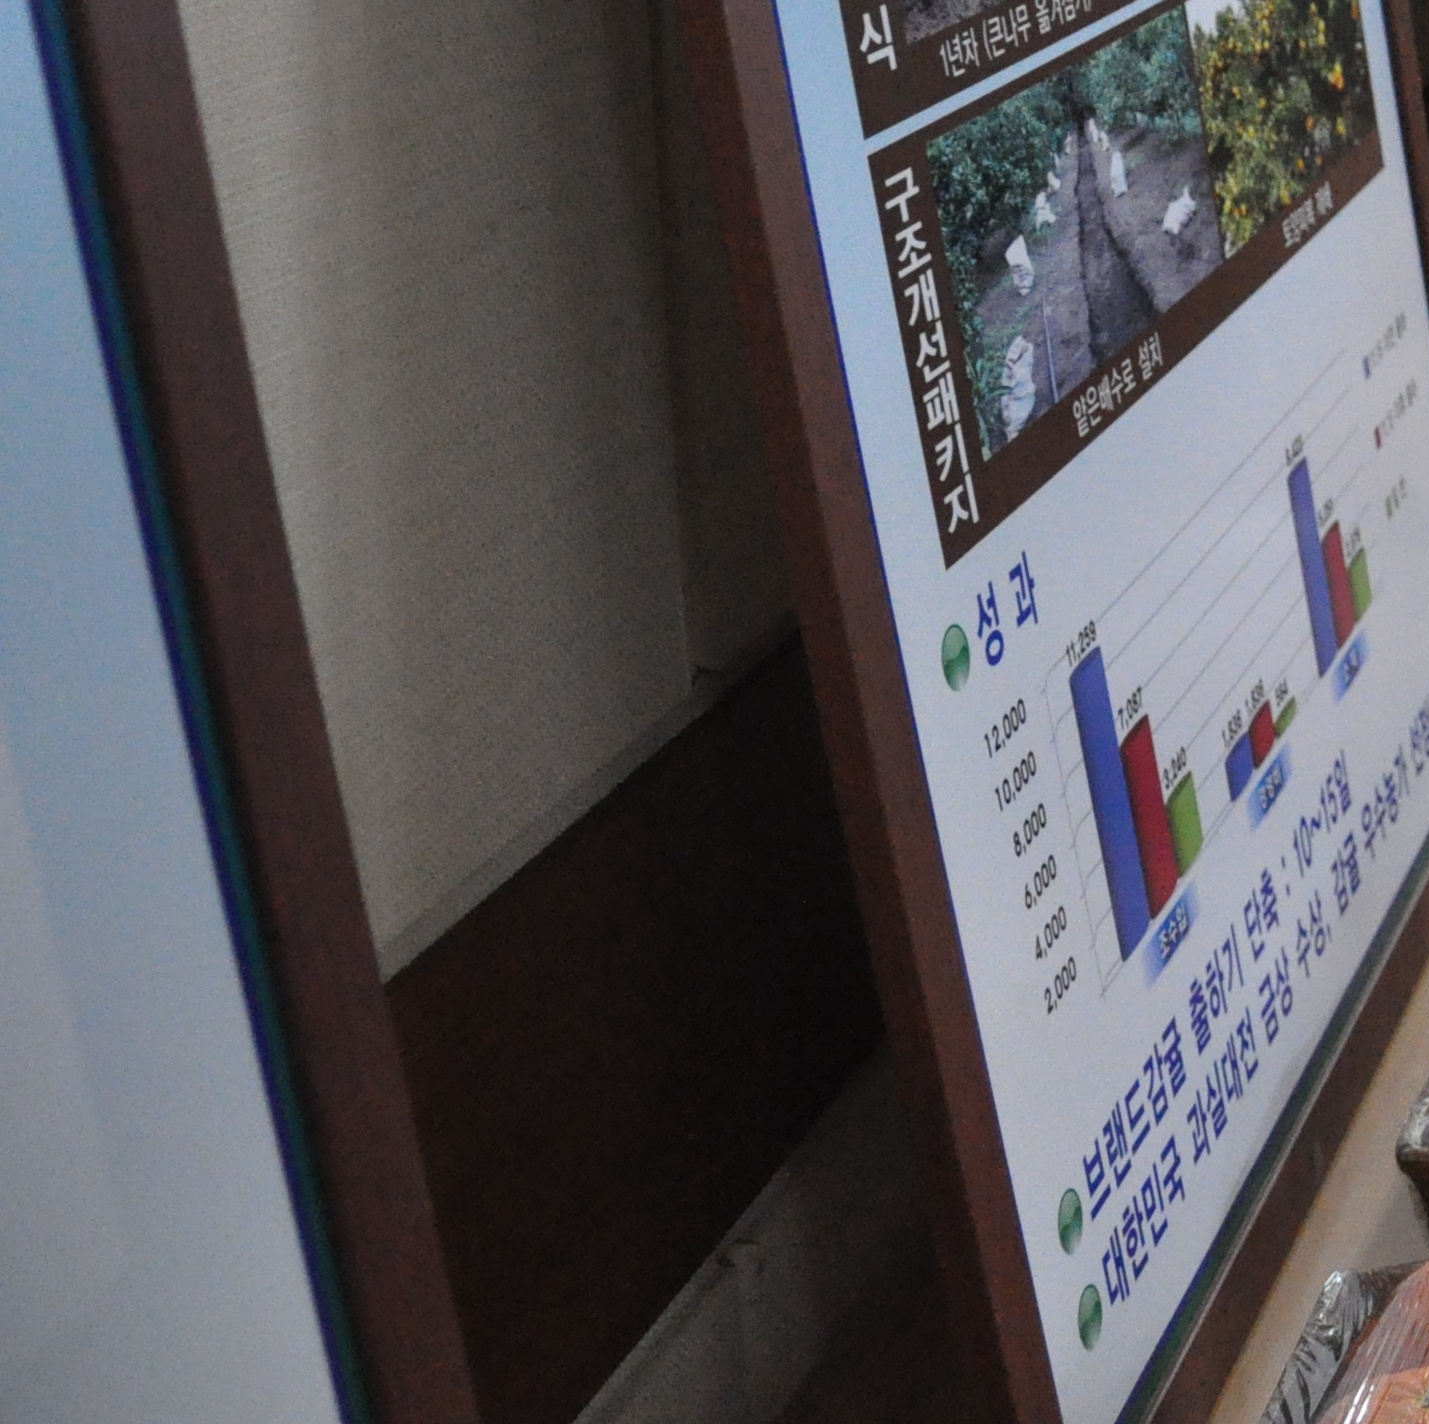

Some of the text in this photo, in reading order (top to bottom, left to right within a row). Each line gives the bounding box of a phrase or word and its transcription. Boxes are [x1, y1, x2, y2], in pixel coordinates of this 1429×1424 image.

[939, 34, 981, 78] 1년차
[982, 3, 1031, 60] (큰나무
[885, 168, 979, 533] 구조개선패키지
[1138, 331, 1164, 383] 설치
[1065, 620, 1097, 667] 11,259
[984, 698, 1027, 759] 12,000
[994, 750, 1037, 813] 10,000
[1013, 803, 1047, 858] 8,000
[1024, 854, 1057, 910] 6,000
[1035, 905, 1067, 961] 4,000
[1044, 956, 1077, 1014] 2,000
[1083, 1016, 1187, 1222] 브랜드감귤
[1189, 922, 1244, 1056] 출하기
[1243, 869, 1279, 963] 단축
[1294, 748, 1352, 878] 10~15일
[1102, 1133, 1186, 1306] 대한민국
[1187, 1005, 1259, 1166] 과실대전
[1258, 946, 1294, 1047] 금상
[1331, 830, 1361, 918] 감귤
